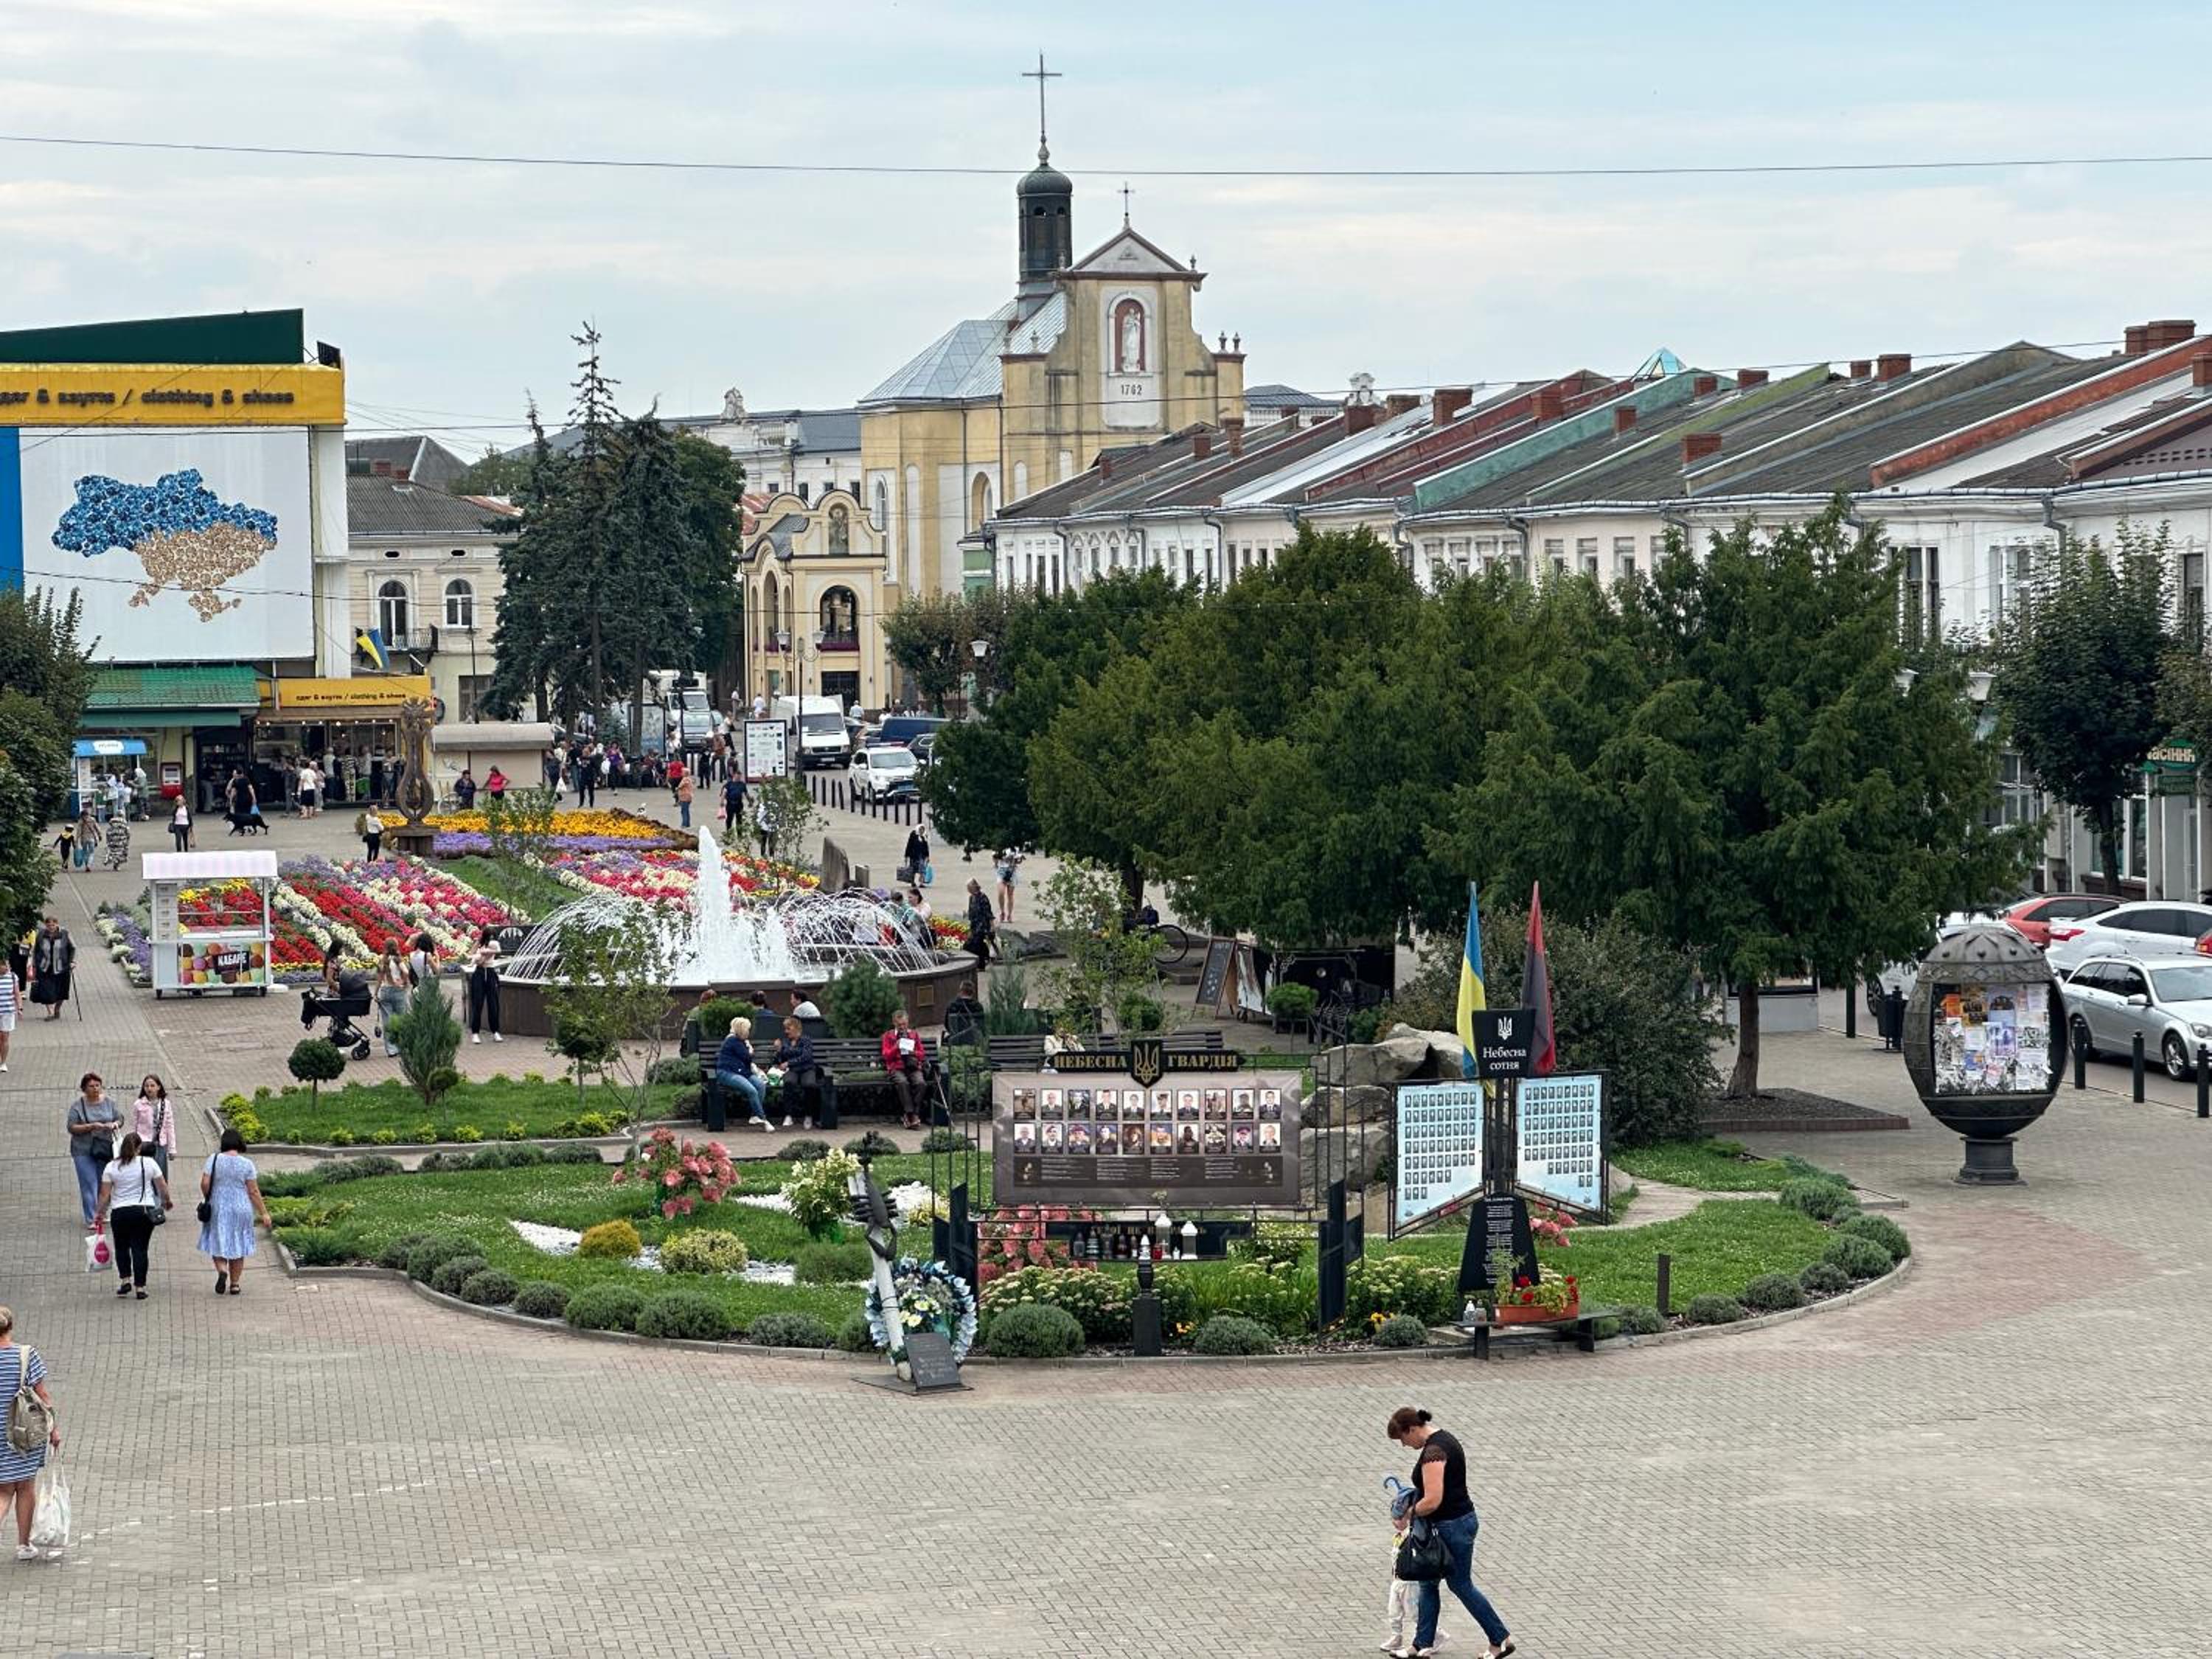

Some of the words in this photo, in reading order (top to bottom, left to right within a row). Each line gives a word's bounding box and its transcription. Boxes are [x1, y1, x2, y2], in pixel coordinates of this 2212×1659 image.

[1121, 384, 1142, 395] 1762
[142, 389, 213, 407] clothing
[243, 389, 294, 403] shoes
[1483, 1046, 1526, 1058] Небесна
[1054, 1055, 1127, 1068] НЕБЕСНА
[1168, 1055, 1238, 1069] ГВАРДІЯ
[1489, 1062, 1520, 1070] сотня
